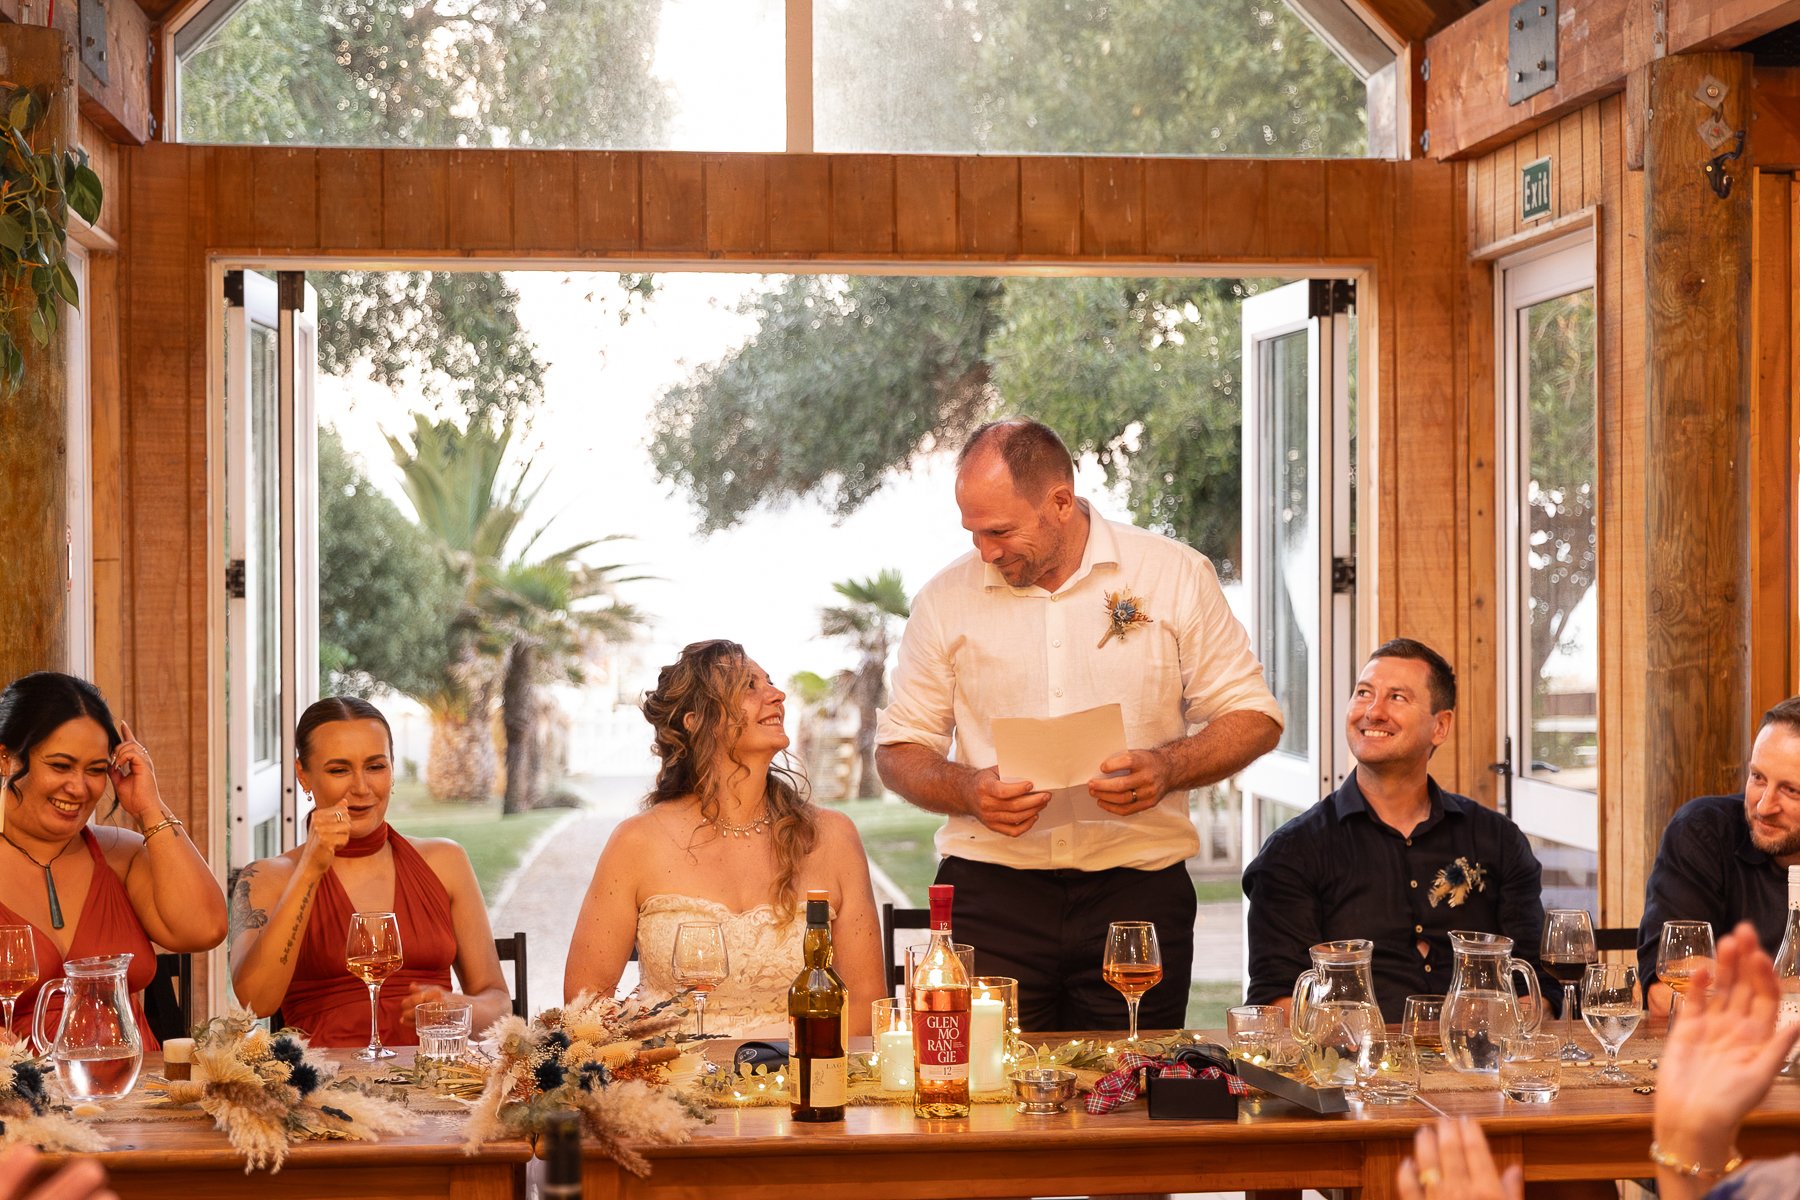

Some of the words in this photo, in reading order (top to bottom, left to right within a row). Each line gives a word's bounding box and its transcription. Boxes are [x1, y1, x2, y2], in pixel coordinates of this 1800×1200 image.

[1524, 171, 1548, 211] Exit
[940, 922, 948, 930] 12
[926, 1016, 959, 1029] GLEN
[938, 1028, 960, 1040] MO
[927, 1039, 953, 1051] RAN
[937, 1050, 957, 1064] GIE
[943, 1066, 952, 1076] 12
